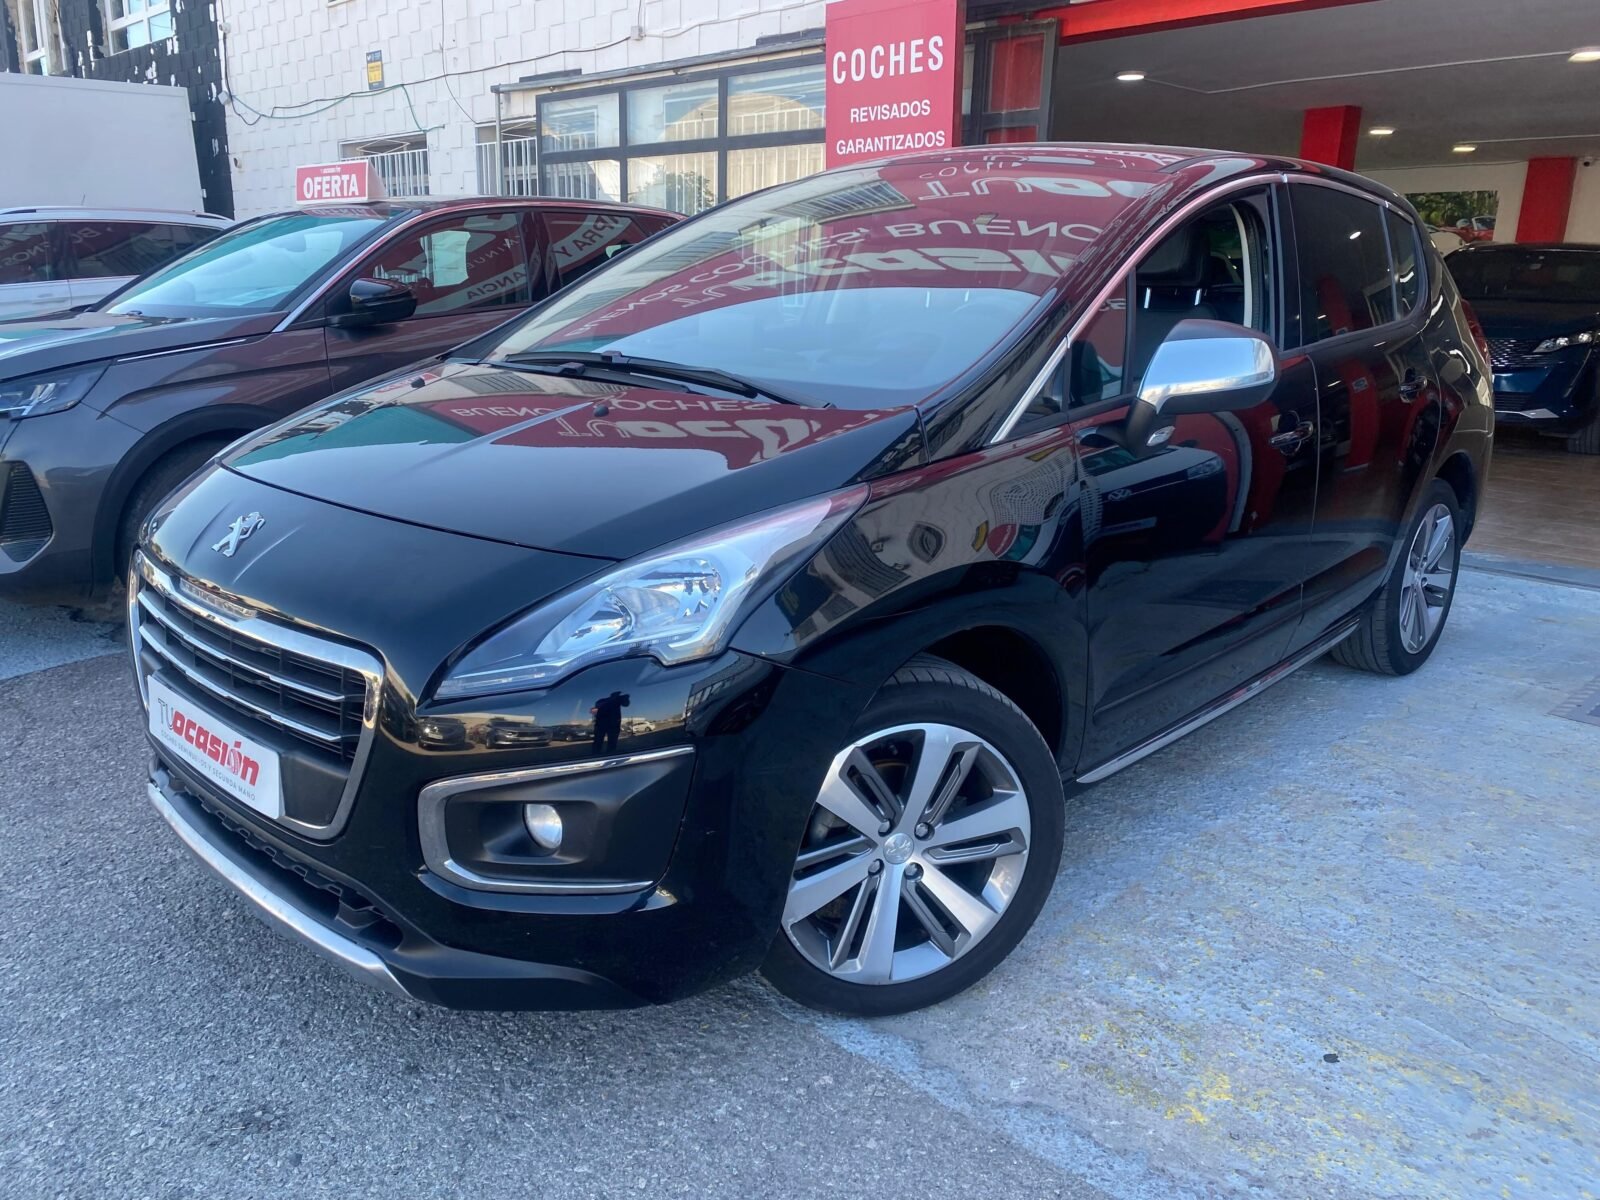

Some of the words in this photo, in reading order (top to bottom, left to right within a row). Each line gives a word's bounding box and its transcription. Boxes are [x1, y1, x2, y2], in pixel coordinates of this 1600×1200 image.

[833, 35, 944, 84] COCHES
[850, 99, 931, 123] REVISADOS
[836, 130, 946, 155] GARANTIZADOS
[303, 174, 359, 199] OFERTA
[238, 786, 256, 801] MANO
